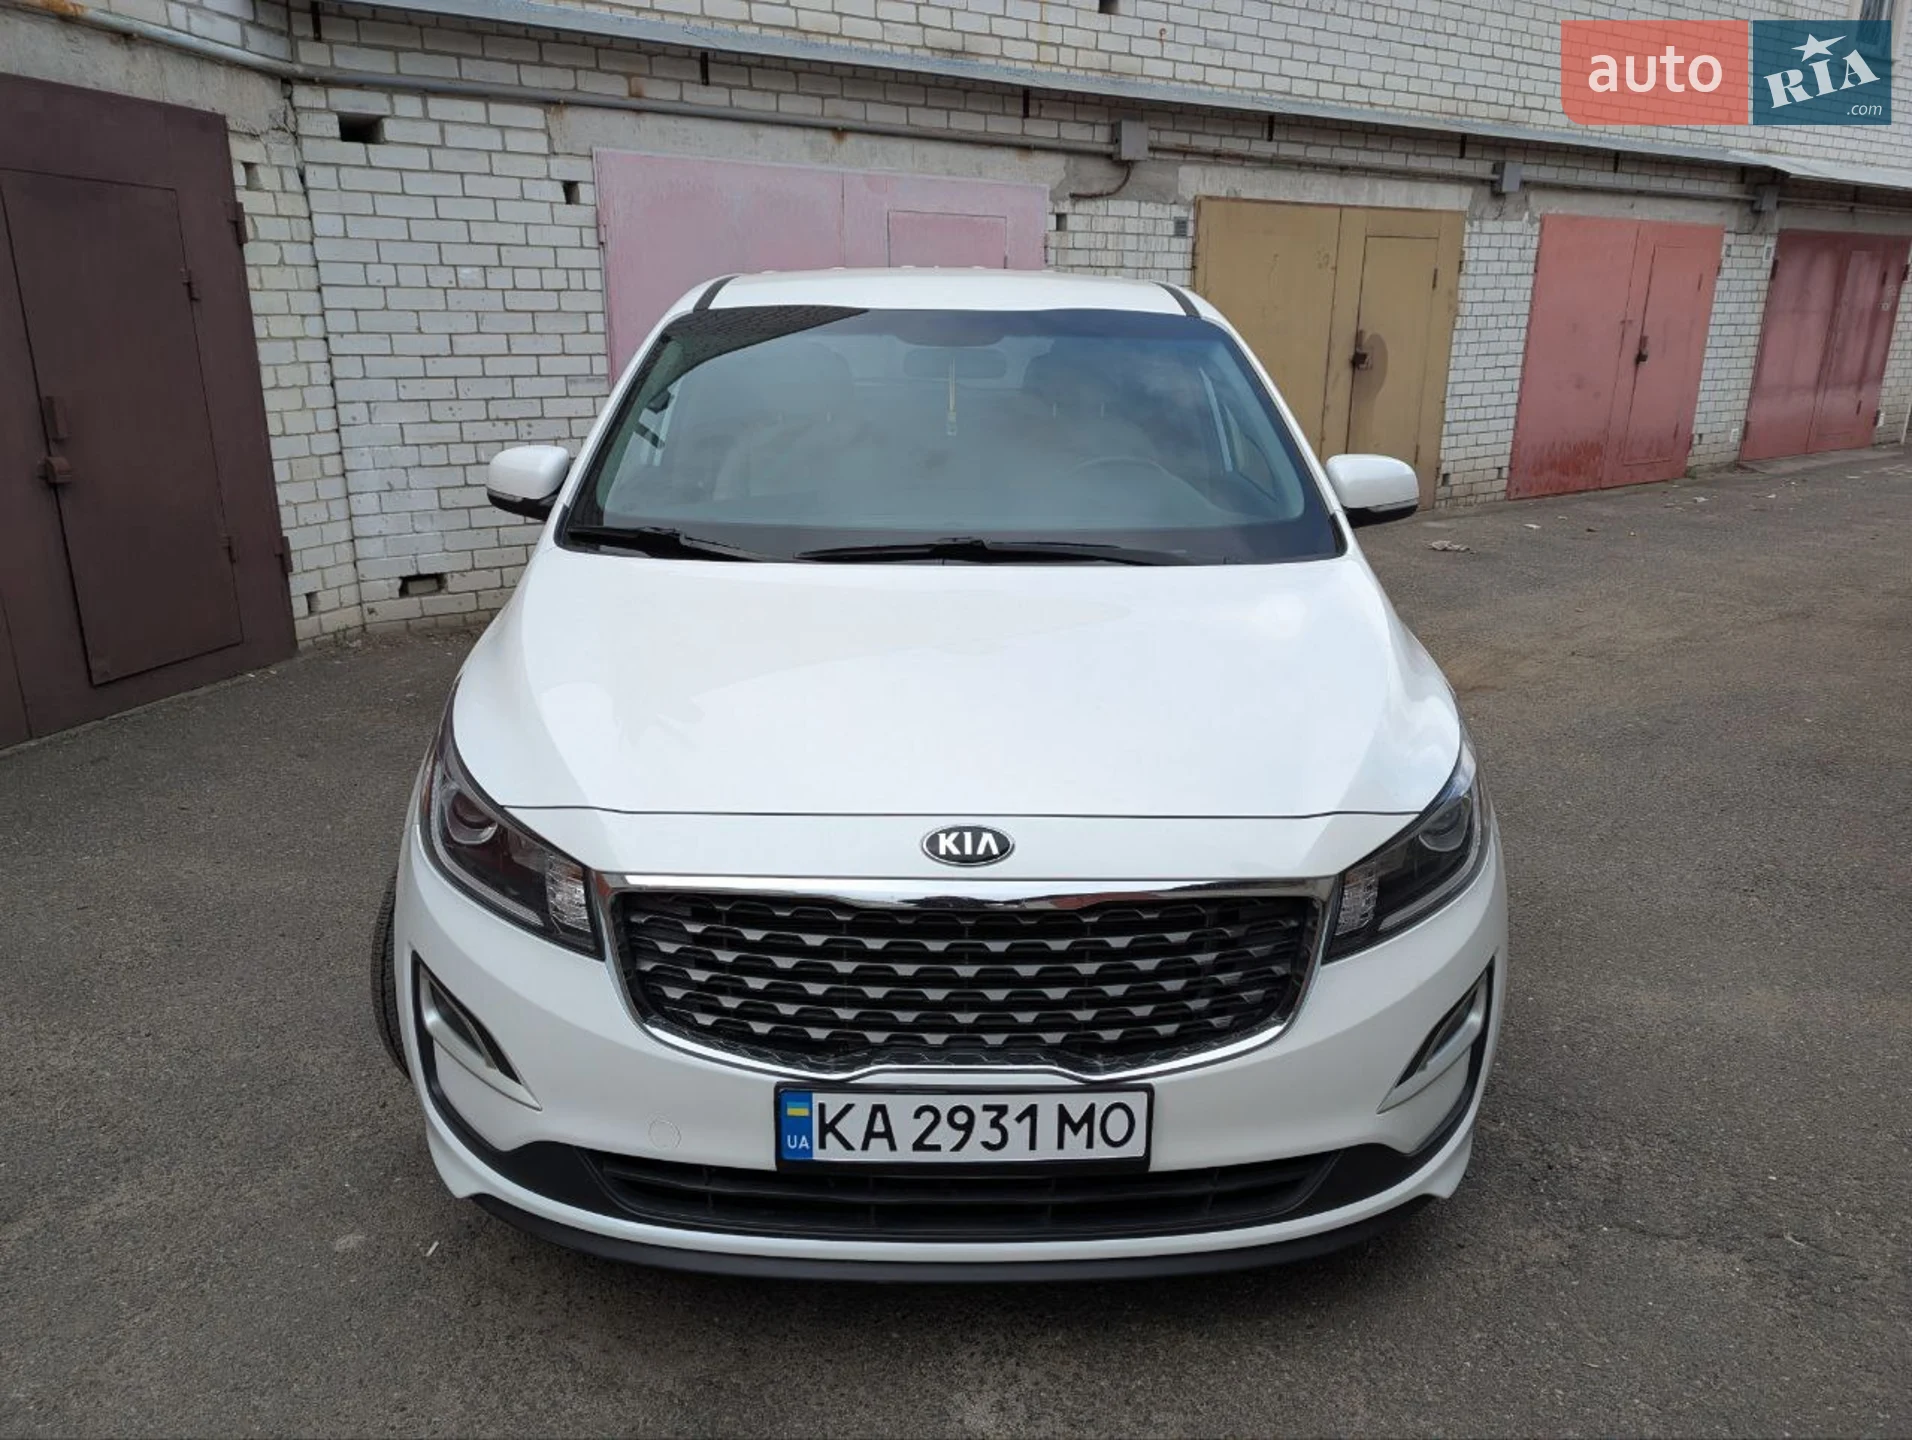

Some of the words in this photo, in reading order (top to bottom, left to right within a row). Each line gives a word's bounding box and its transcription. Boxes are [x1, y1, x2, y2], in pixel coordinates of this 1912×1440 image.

[937, 831, 999, 856] KIA
[817, 1102, 897, 1152] KA
[911, 1103, 1038, 1152] 2931
[1056, 1101, 1136, 1150] MO
[786, 1133, 810, 1151] UA
